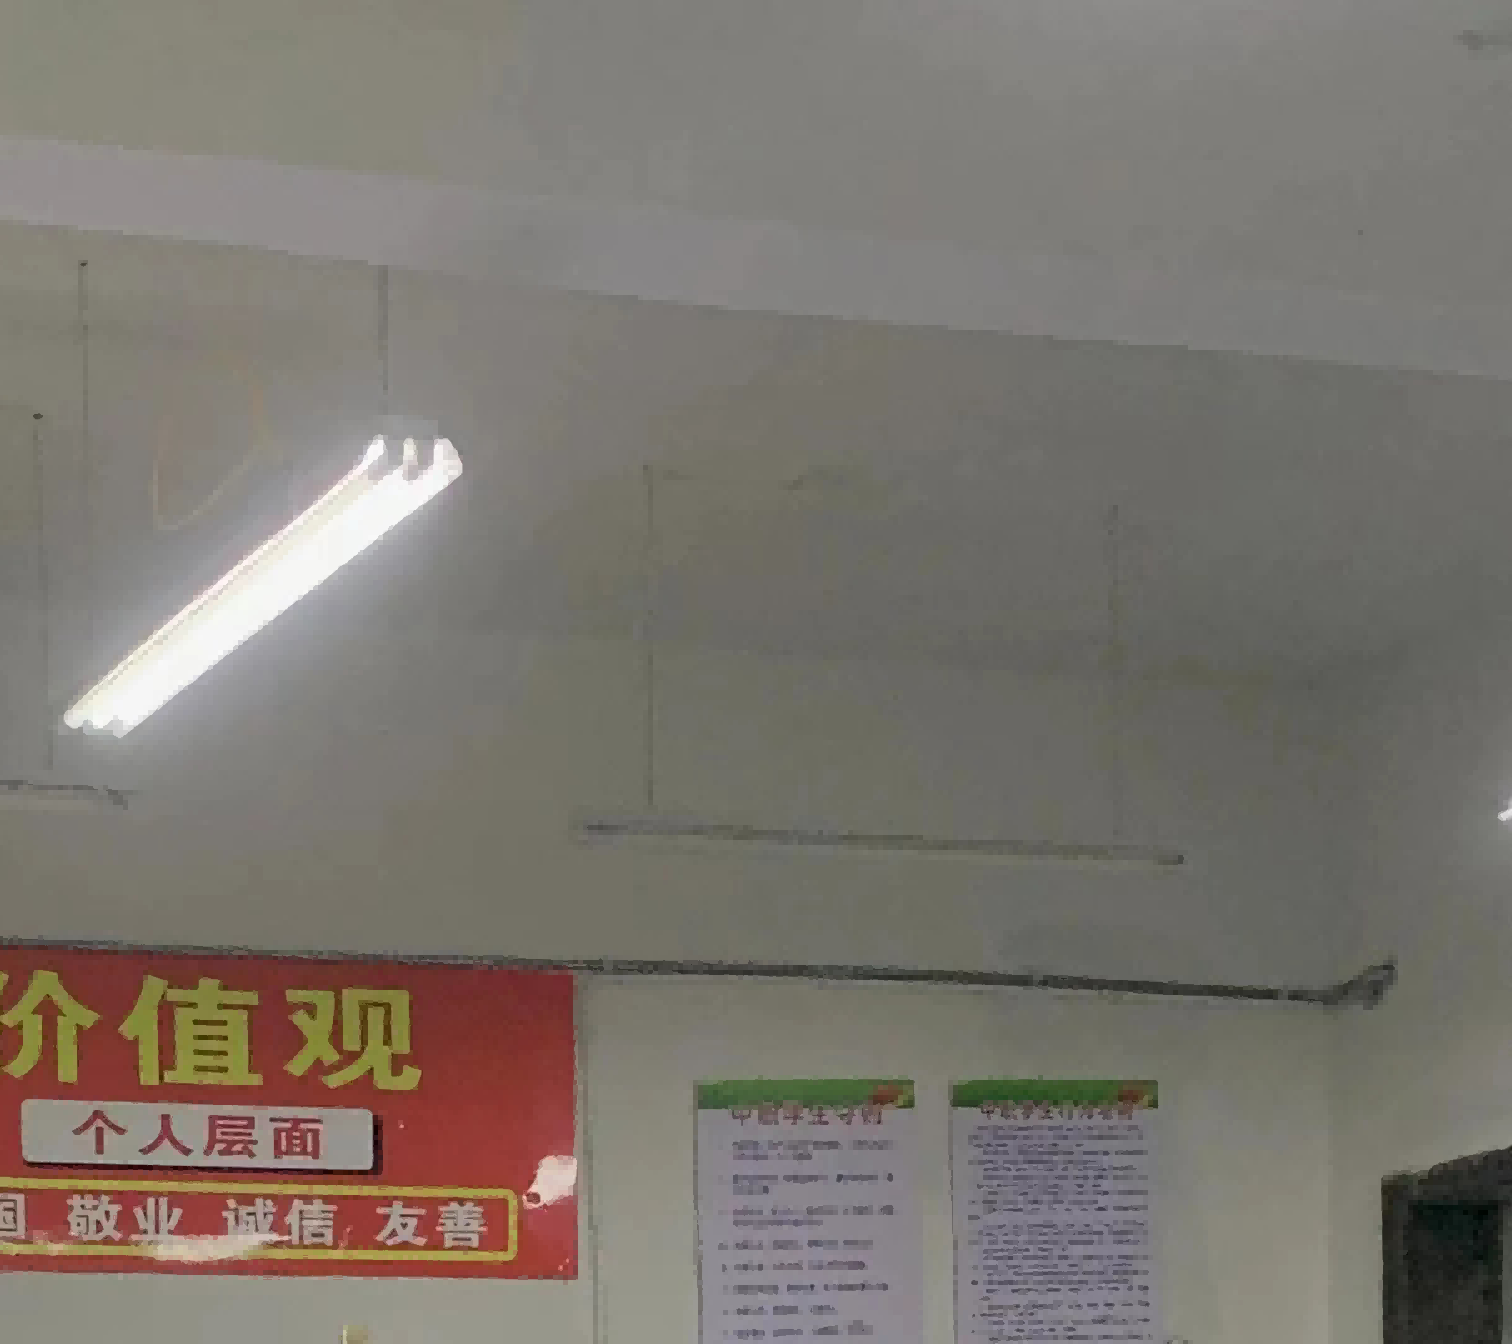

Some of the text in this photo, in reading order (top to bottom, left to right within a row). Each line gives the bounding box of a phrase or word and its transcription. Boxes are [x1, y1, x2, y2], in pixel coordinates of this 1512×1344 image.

[72, 1109, 325, 1161] 个人层面
[66, 1196, 182, 1243] 敬业
[221, 1198, 339, 1247] 诚信
[376, 1200, 489, 1249] 友善
